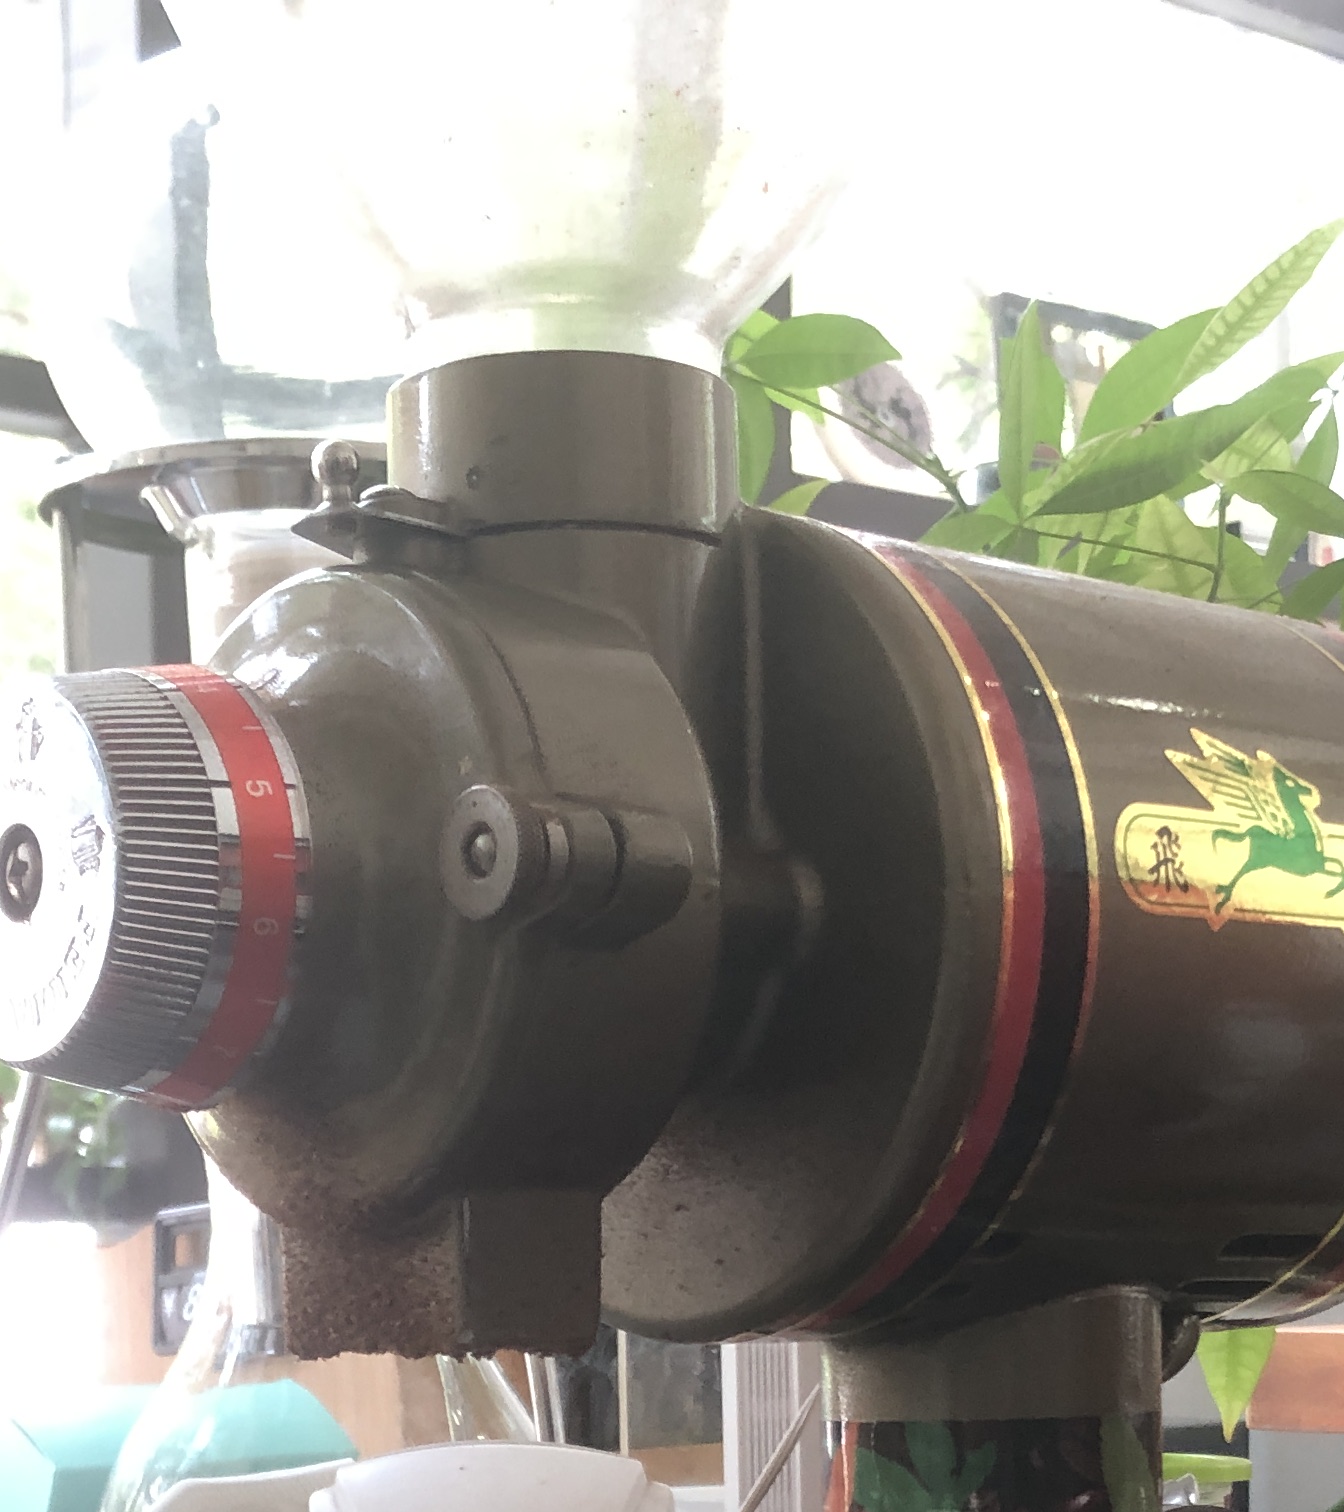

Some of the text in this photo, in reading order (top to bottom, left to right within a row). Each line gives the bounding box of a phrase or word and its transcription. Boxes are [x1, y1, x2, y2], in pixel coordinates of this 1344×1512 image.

[244, 779, 273, 800] 5
[1148, 825, 1190, 894] 飛
[253, 917, 279, 936] 6
